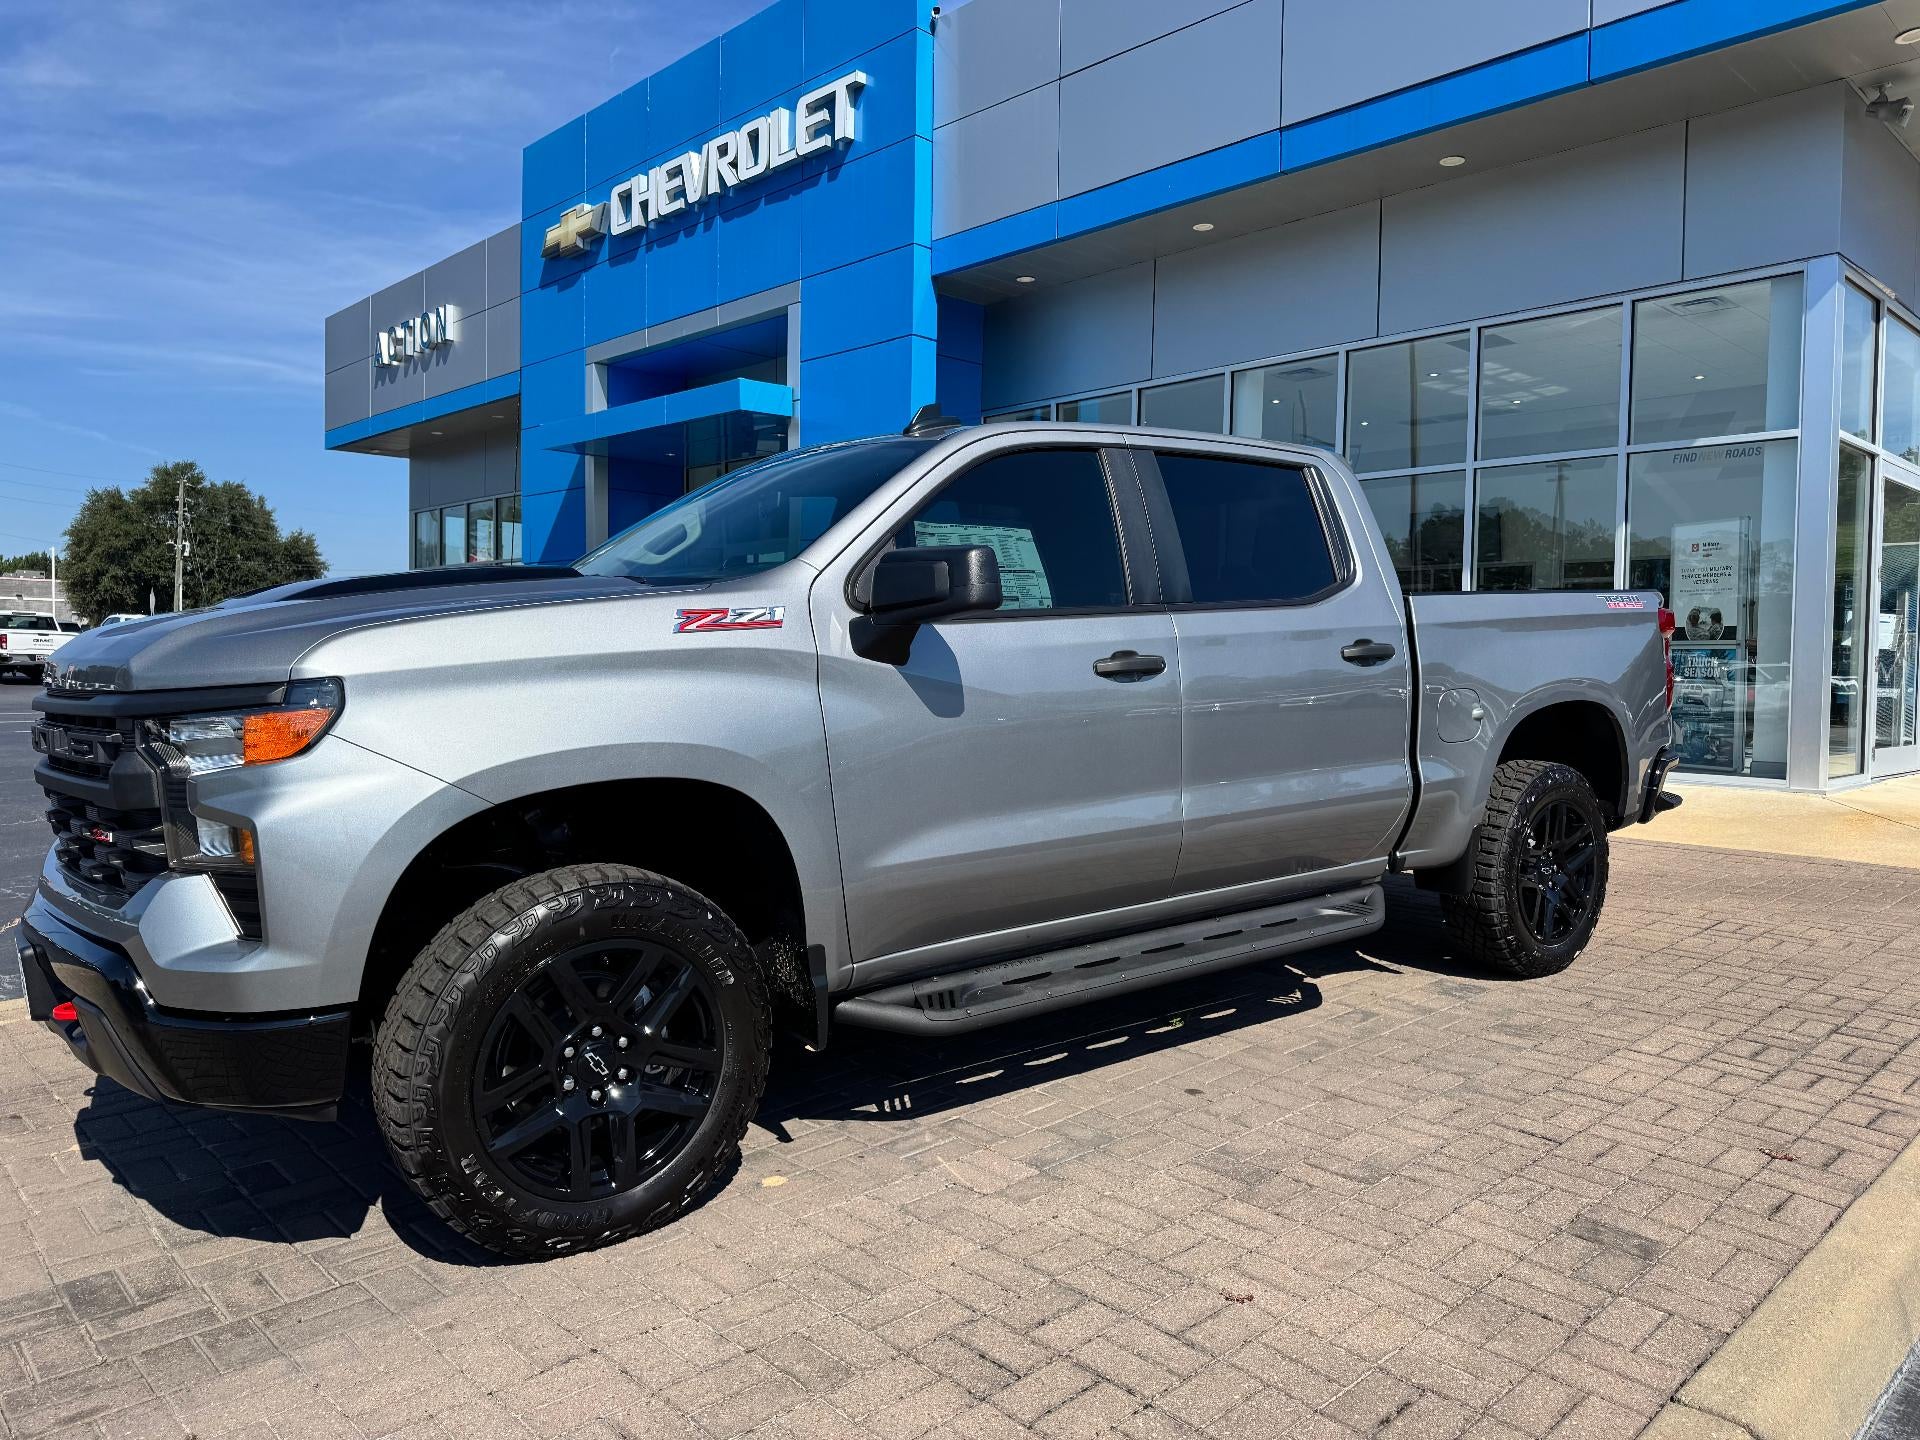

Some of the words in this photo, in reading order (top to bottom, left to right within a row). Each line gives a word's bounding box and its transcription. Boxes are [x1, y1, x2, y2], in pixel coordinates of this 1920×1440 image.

[610, 69, 867, 236] CHEVROLET
[373, 304, 454, 368] ACTION
[1672, 452, 1697, 464] FIND
[1725, 446, 1762, 459] ROADS
[672, 606, 786, 634] Z71
[1684, 667, 1721, 678] SEASON
[1687, 656, 1719, 667] TRUCK
